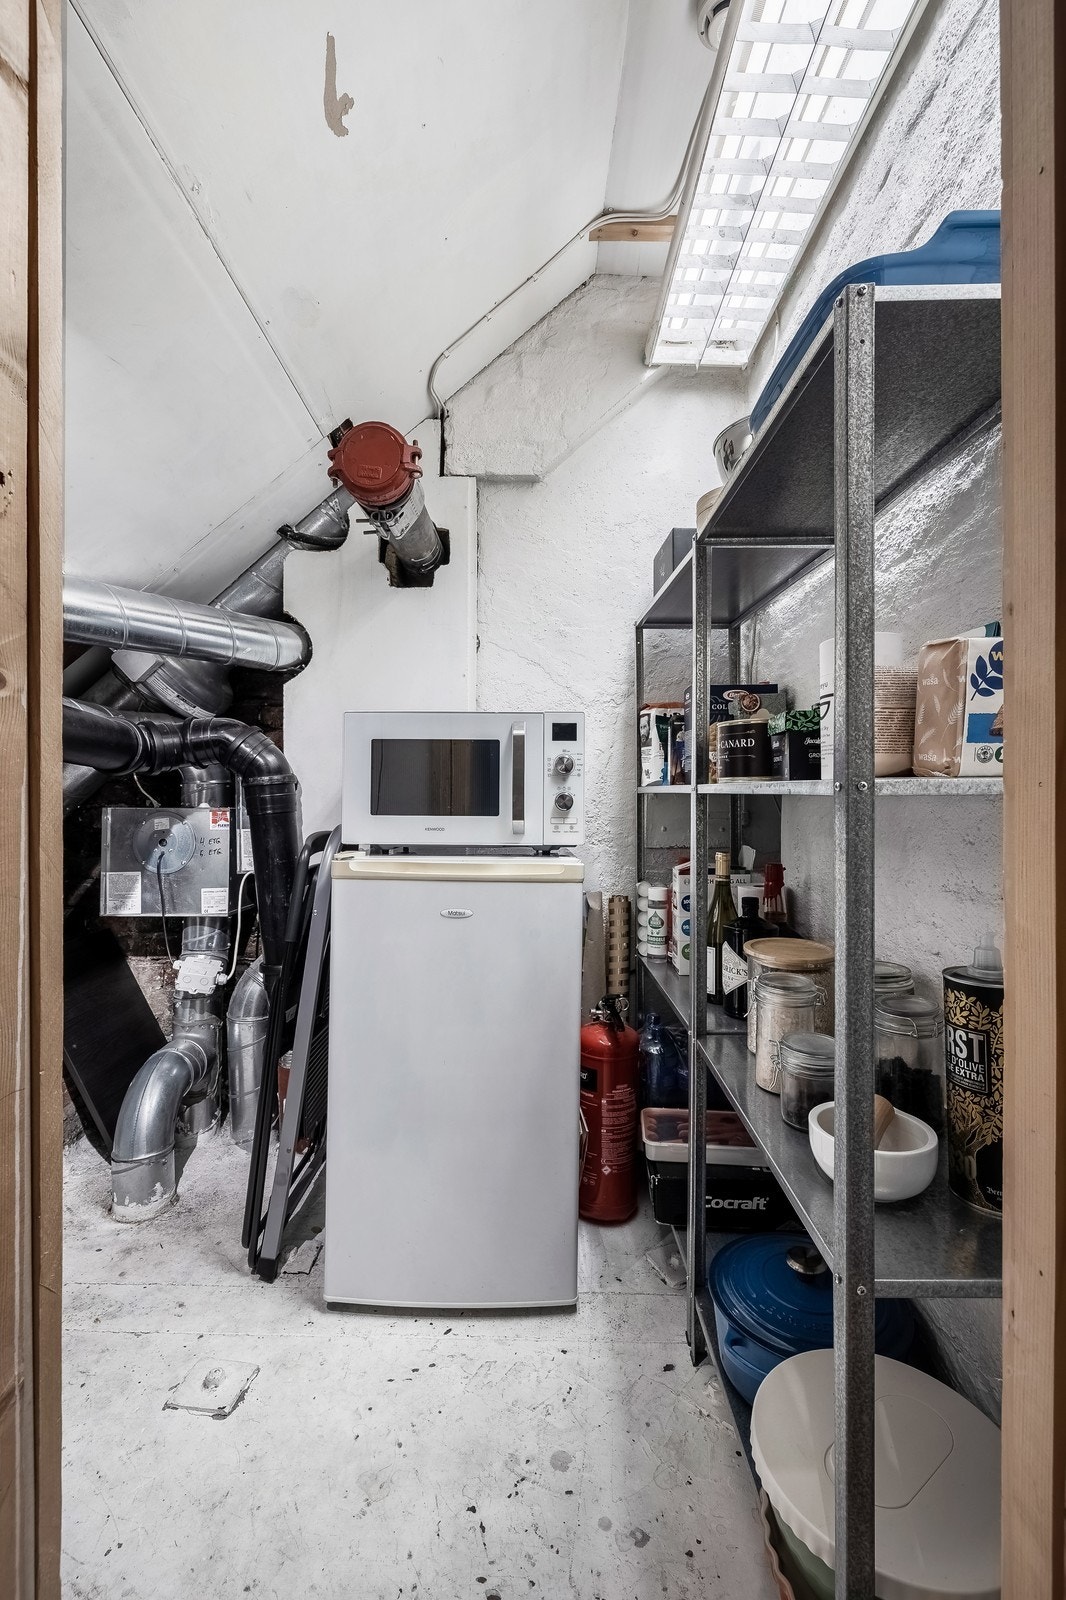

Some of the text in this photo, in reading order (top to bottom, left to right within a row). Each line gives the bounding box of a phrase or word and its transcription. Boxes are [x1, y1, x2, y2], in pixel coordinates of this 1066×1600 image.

[720, 738, 755, 749] CANARD
[952, 1055, 984, 1074] D'OLIVE
[955, 1066, 985, 1083] EXTRA
